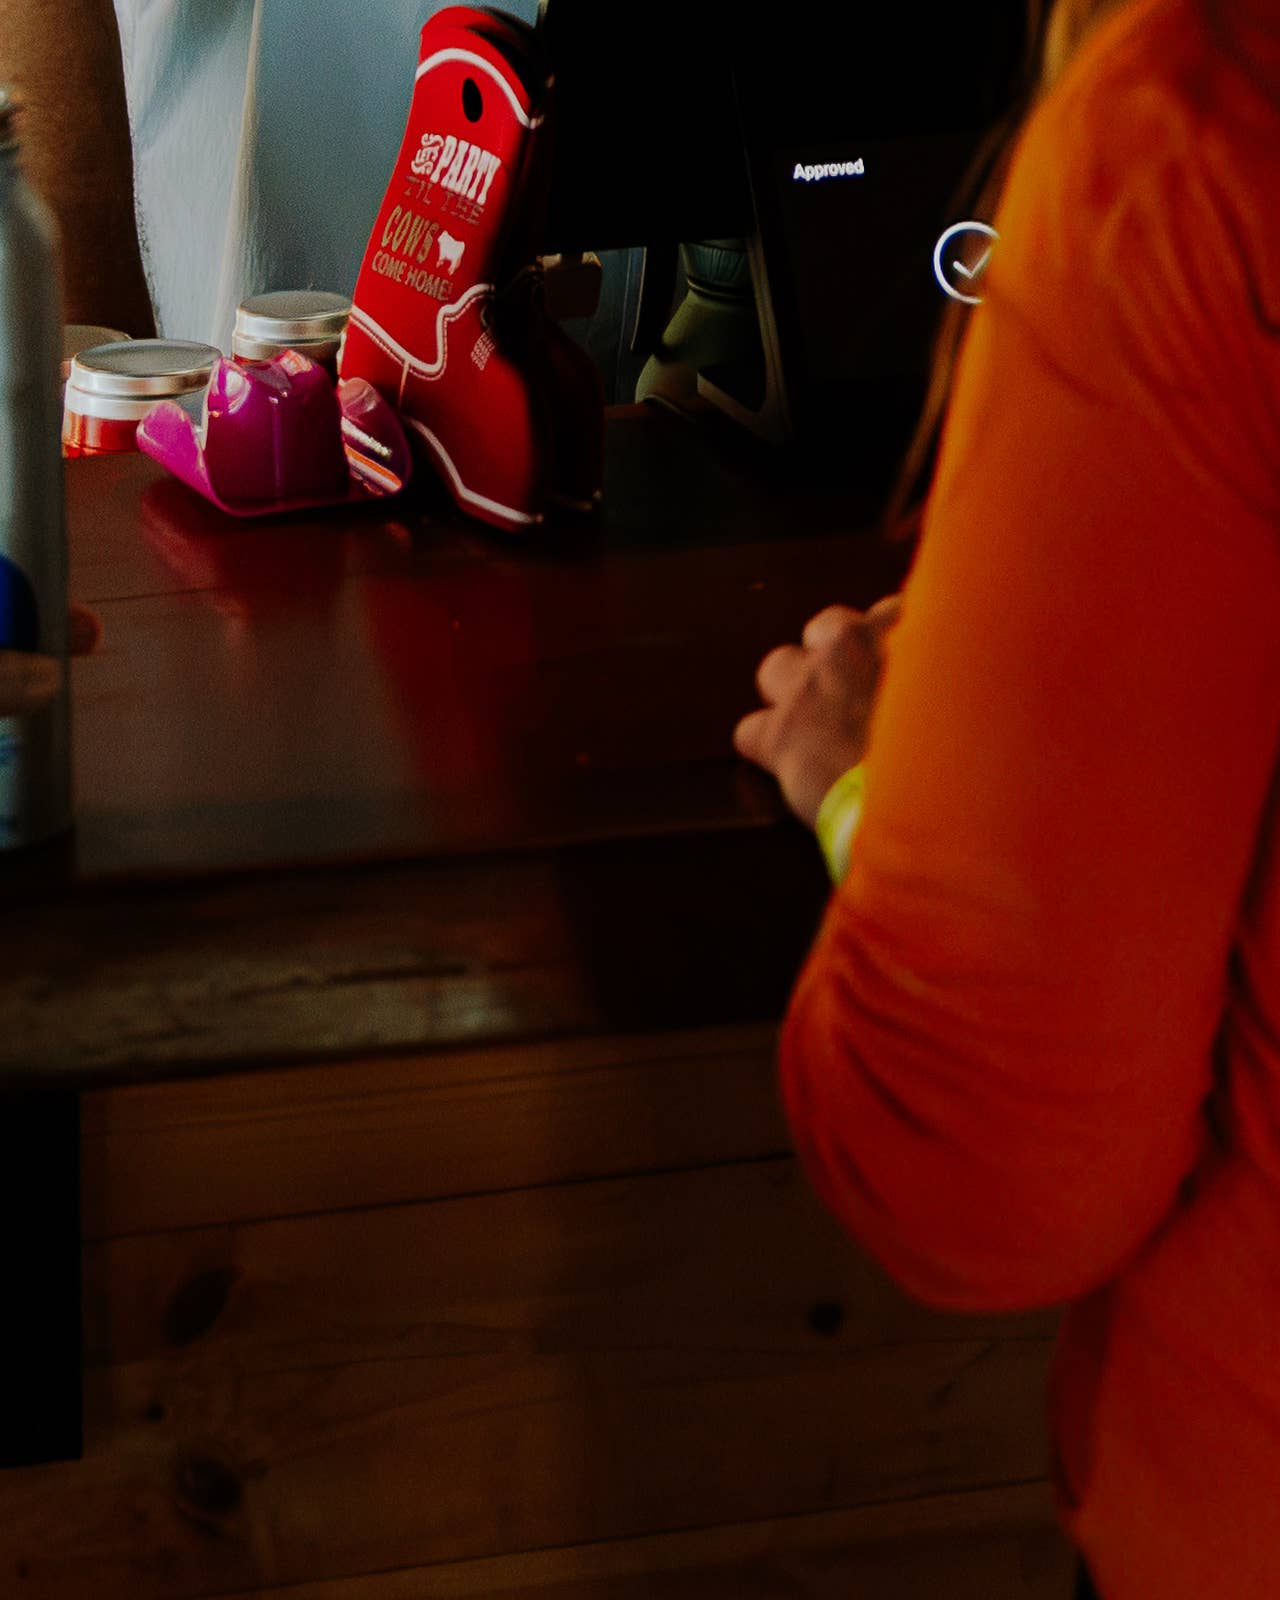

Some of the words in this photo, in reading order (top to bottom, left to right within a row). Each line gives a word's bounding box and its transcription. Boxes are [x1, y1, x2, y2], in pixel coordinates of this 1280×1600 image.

[430, 134, 502, 206] PARTY
[793, 157, 865, 181] Approved
[381, 204, 440, 265] COWS
[371, 249, 408, 283] COME
